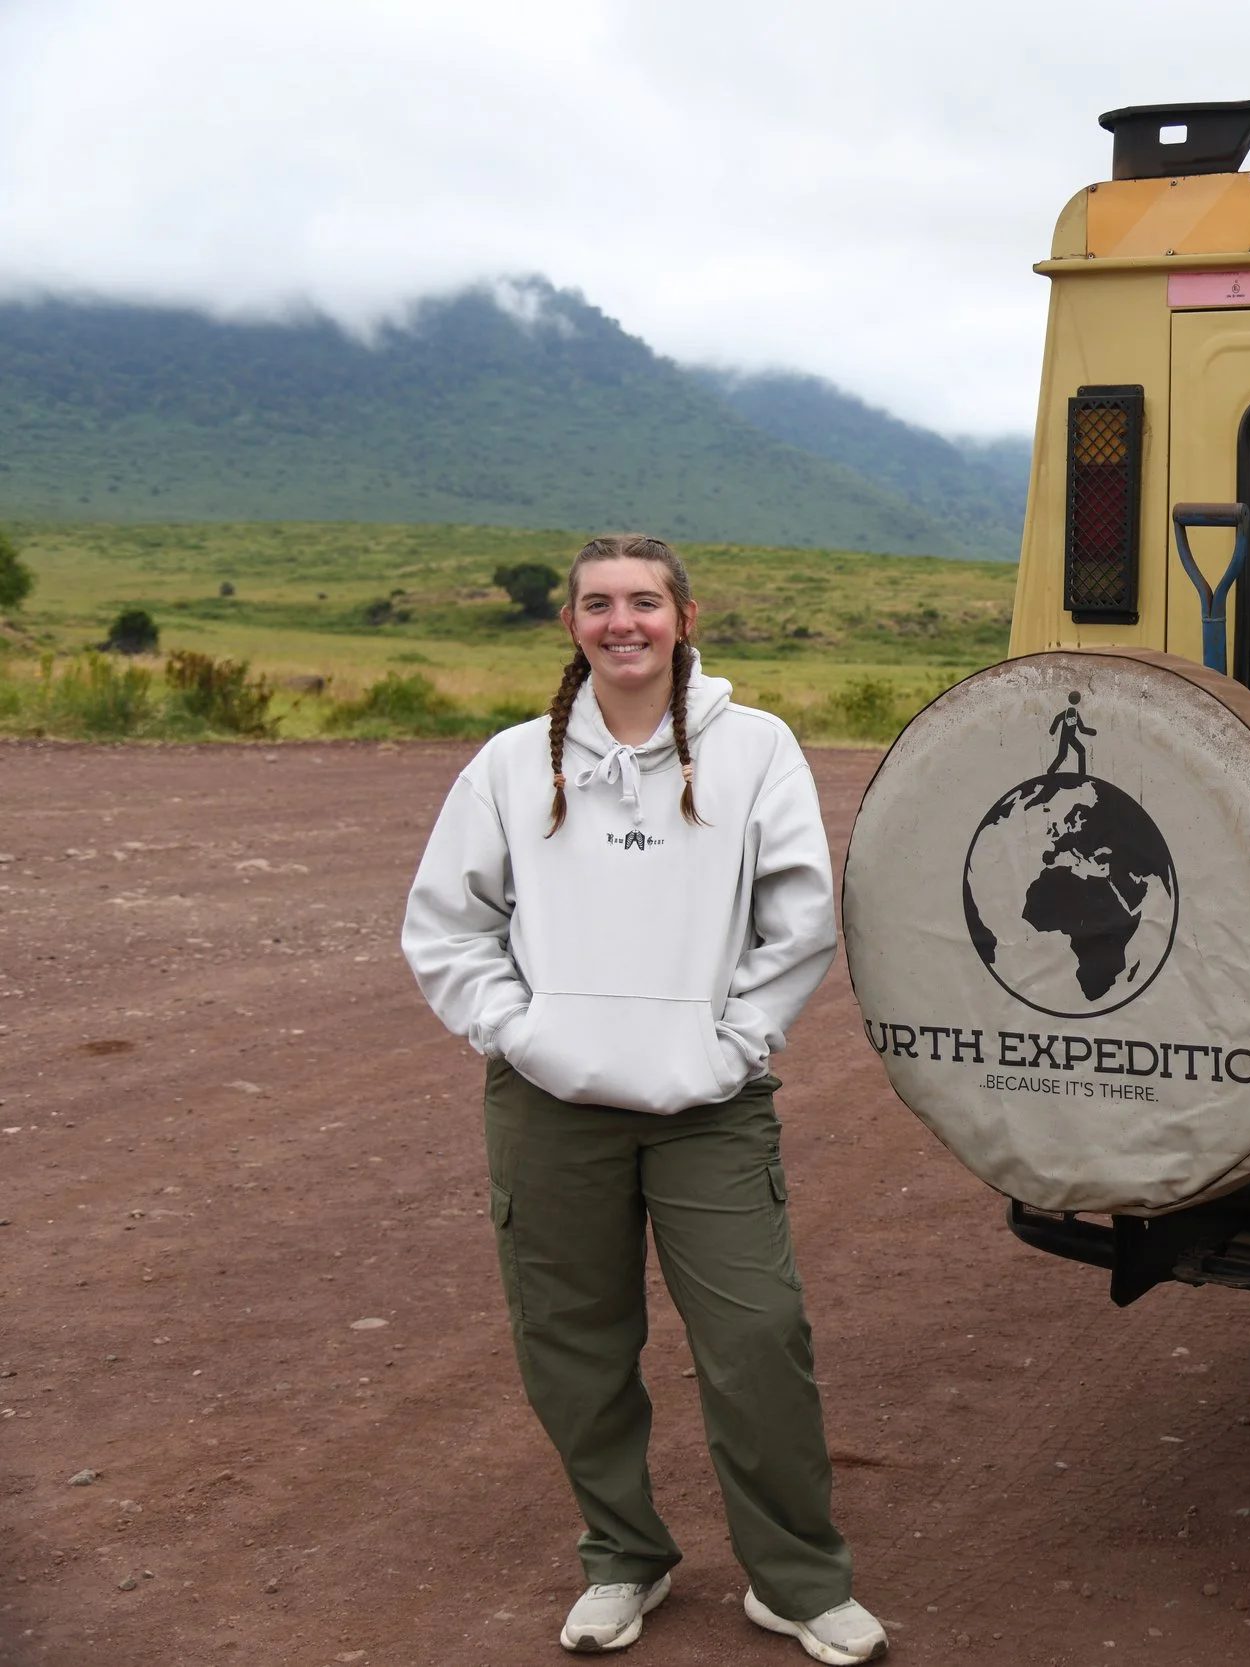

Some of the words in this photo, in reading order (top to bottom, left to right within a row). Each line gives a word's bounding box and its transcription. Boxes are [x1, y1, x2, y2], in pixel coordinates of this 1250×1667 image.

[865, 1018, 985, 1064] URTH
[1065, 1080, 1094, 1098] IT'S
[1099, 1082, 1159, 1103] THERE.
